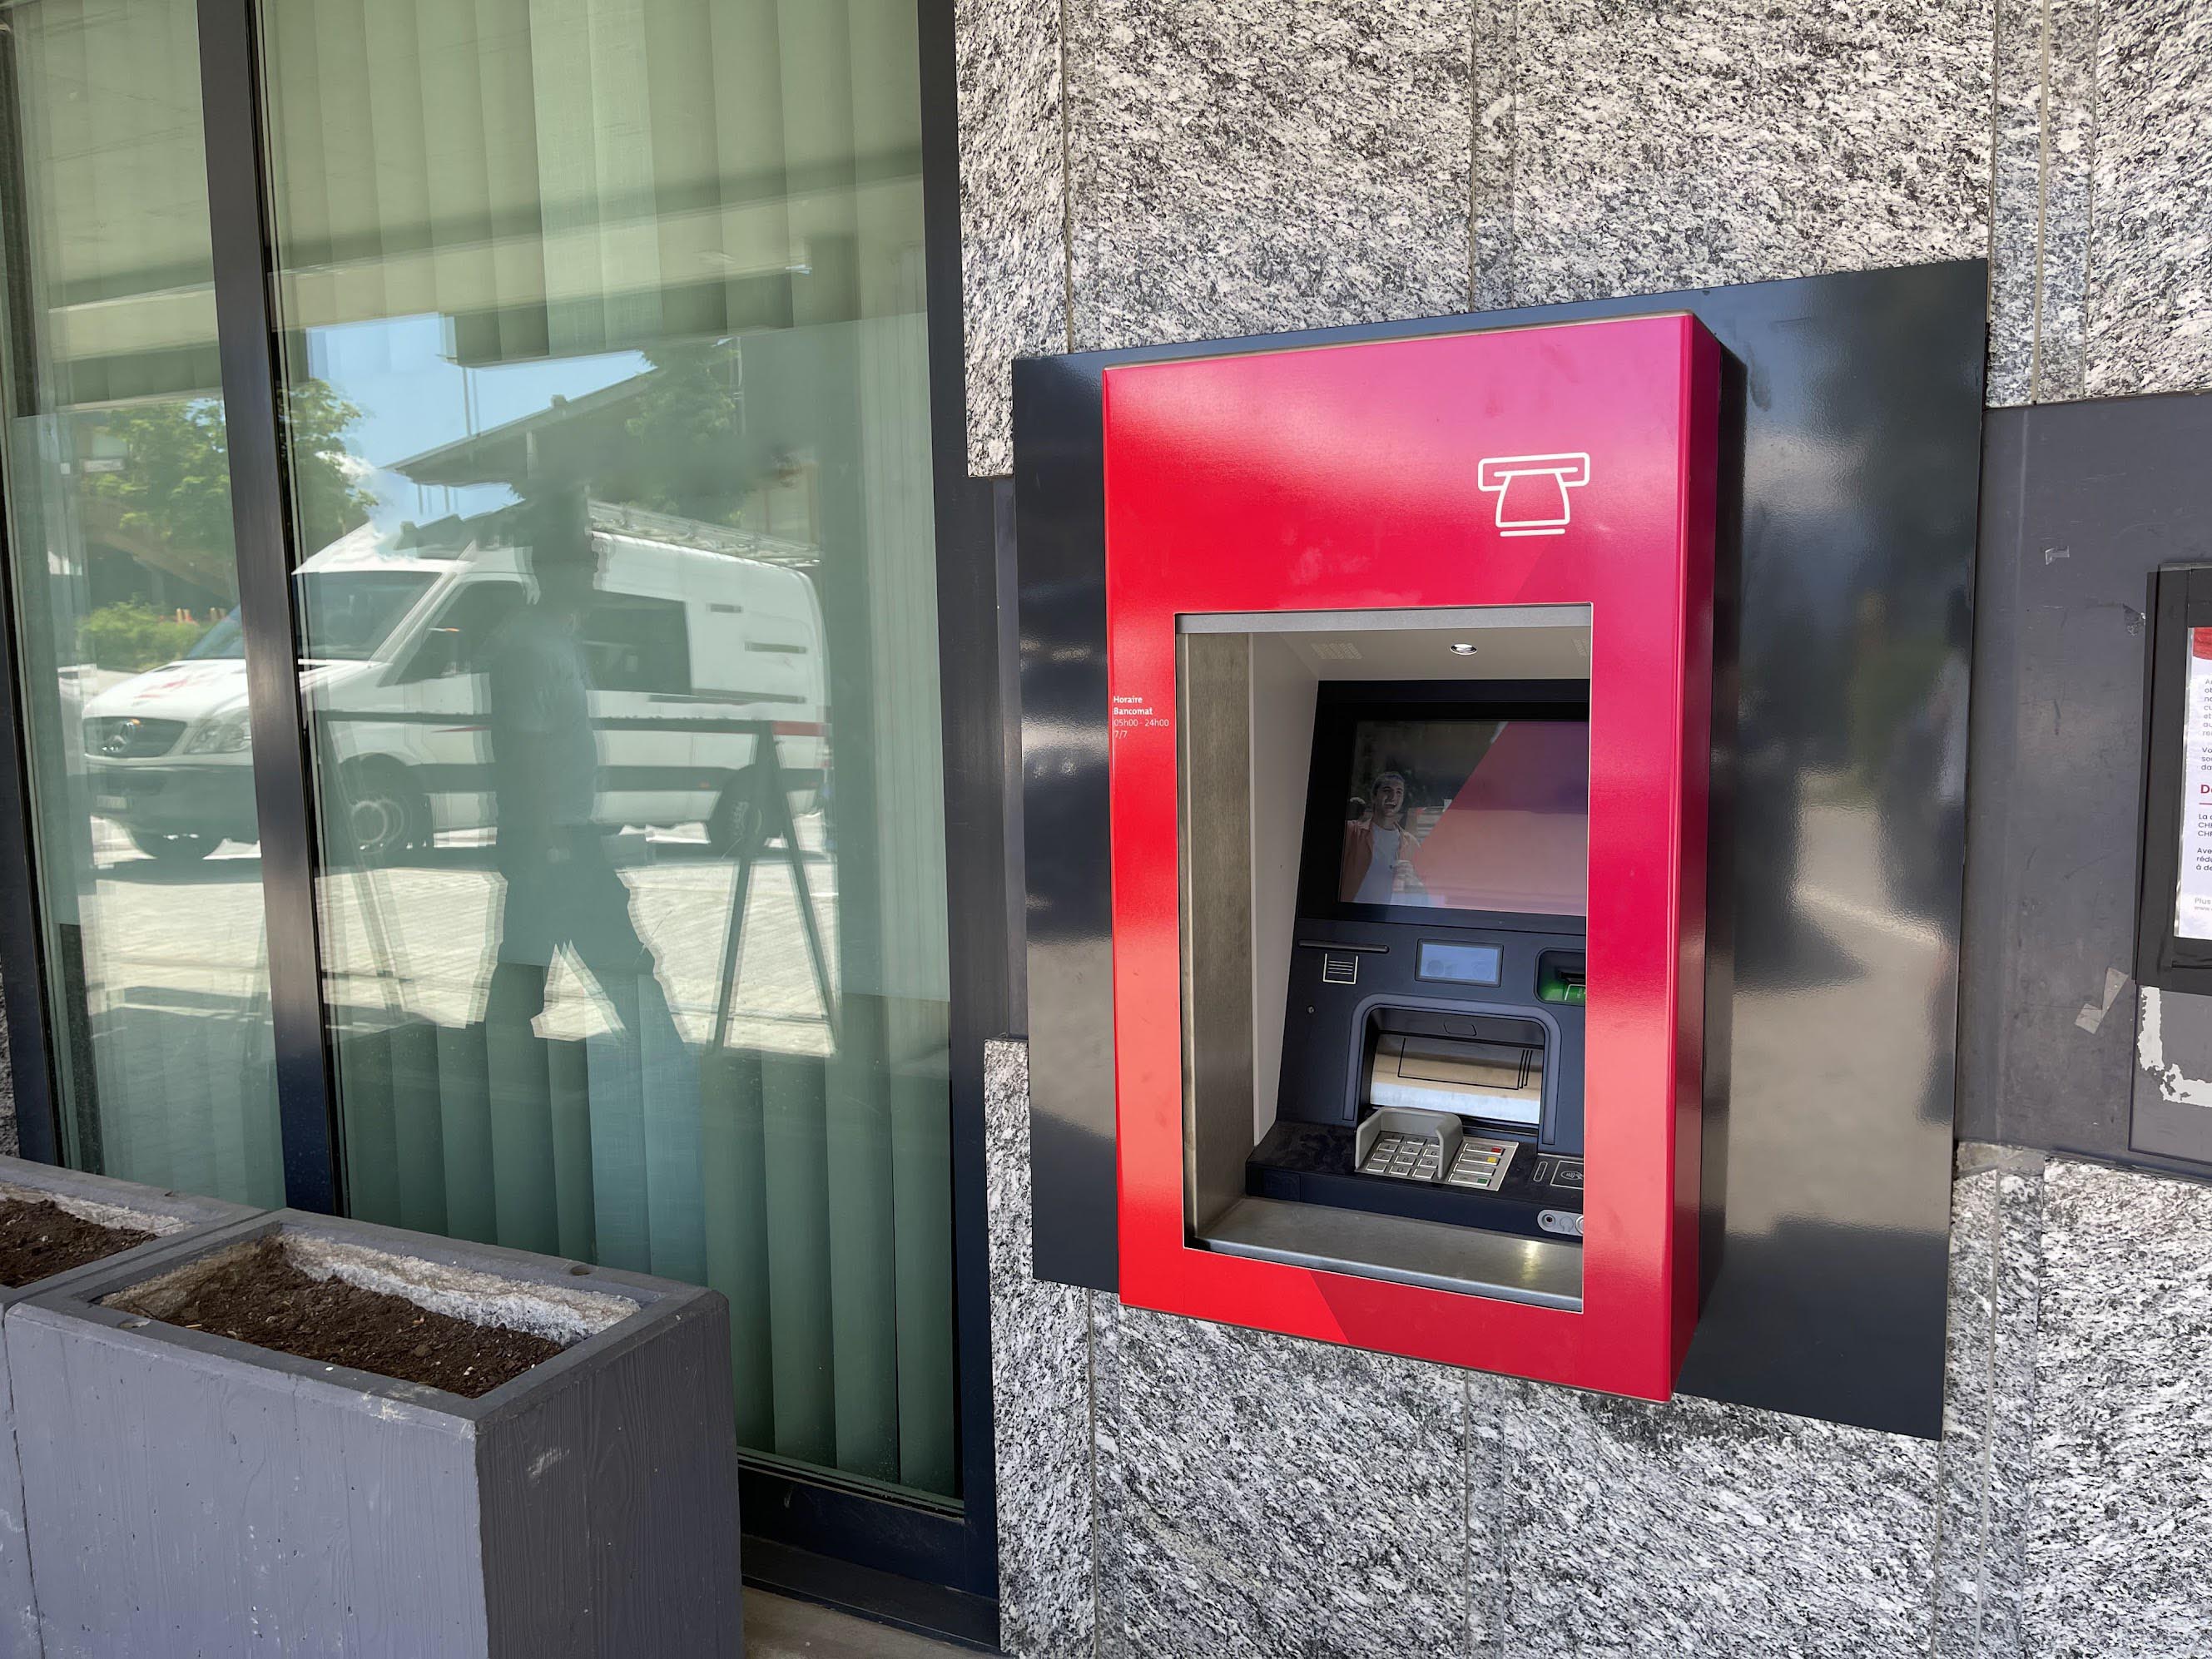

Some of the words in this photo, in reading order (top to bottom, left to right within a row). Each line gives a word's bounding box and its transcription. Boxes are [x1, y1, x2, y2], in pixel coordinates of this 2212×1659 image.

[1113, 696, 1143, 704] Horaire
[1114, 730, 1128, 739] 7/7
[2200, 785, 2212, 794] D
